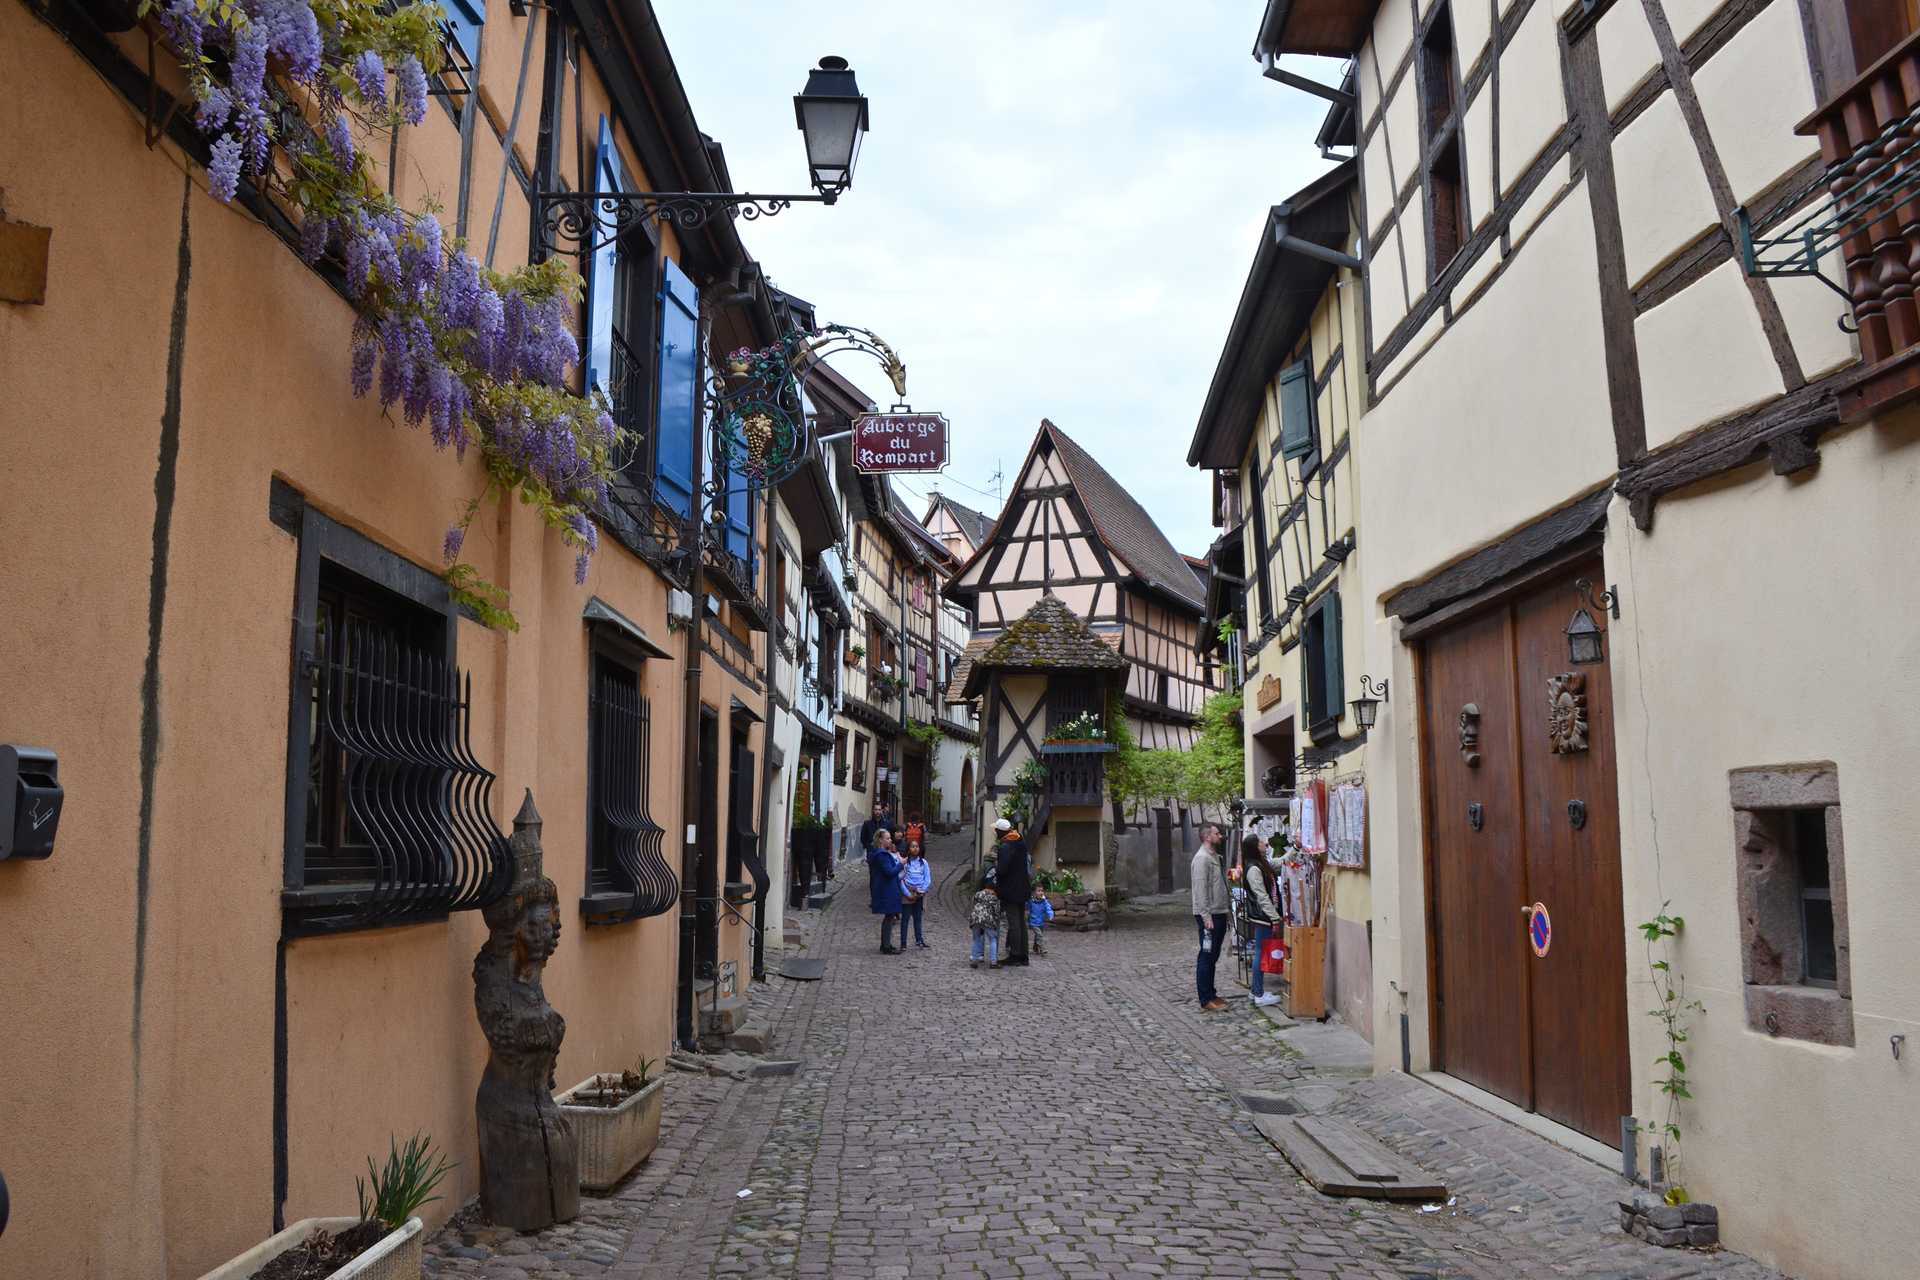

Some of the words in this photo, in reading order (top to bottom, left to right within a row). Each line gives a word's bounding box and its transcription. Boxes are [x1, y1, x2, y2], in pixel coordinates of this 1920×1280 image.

[862, 419, 937, 438] Auberge
[890, 436, 910, 449] du
[859, 448, 937, 467] Rempart
